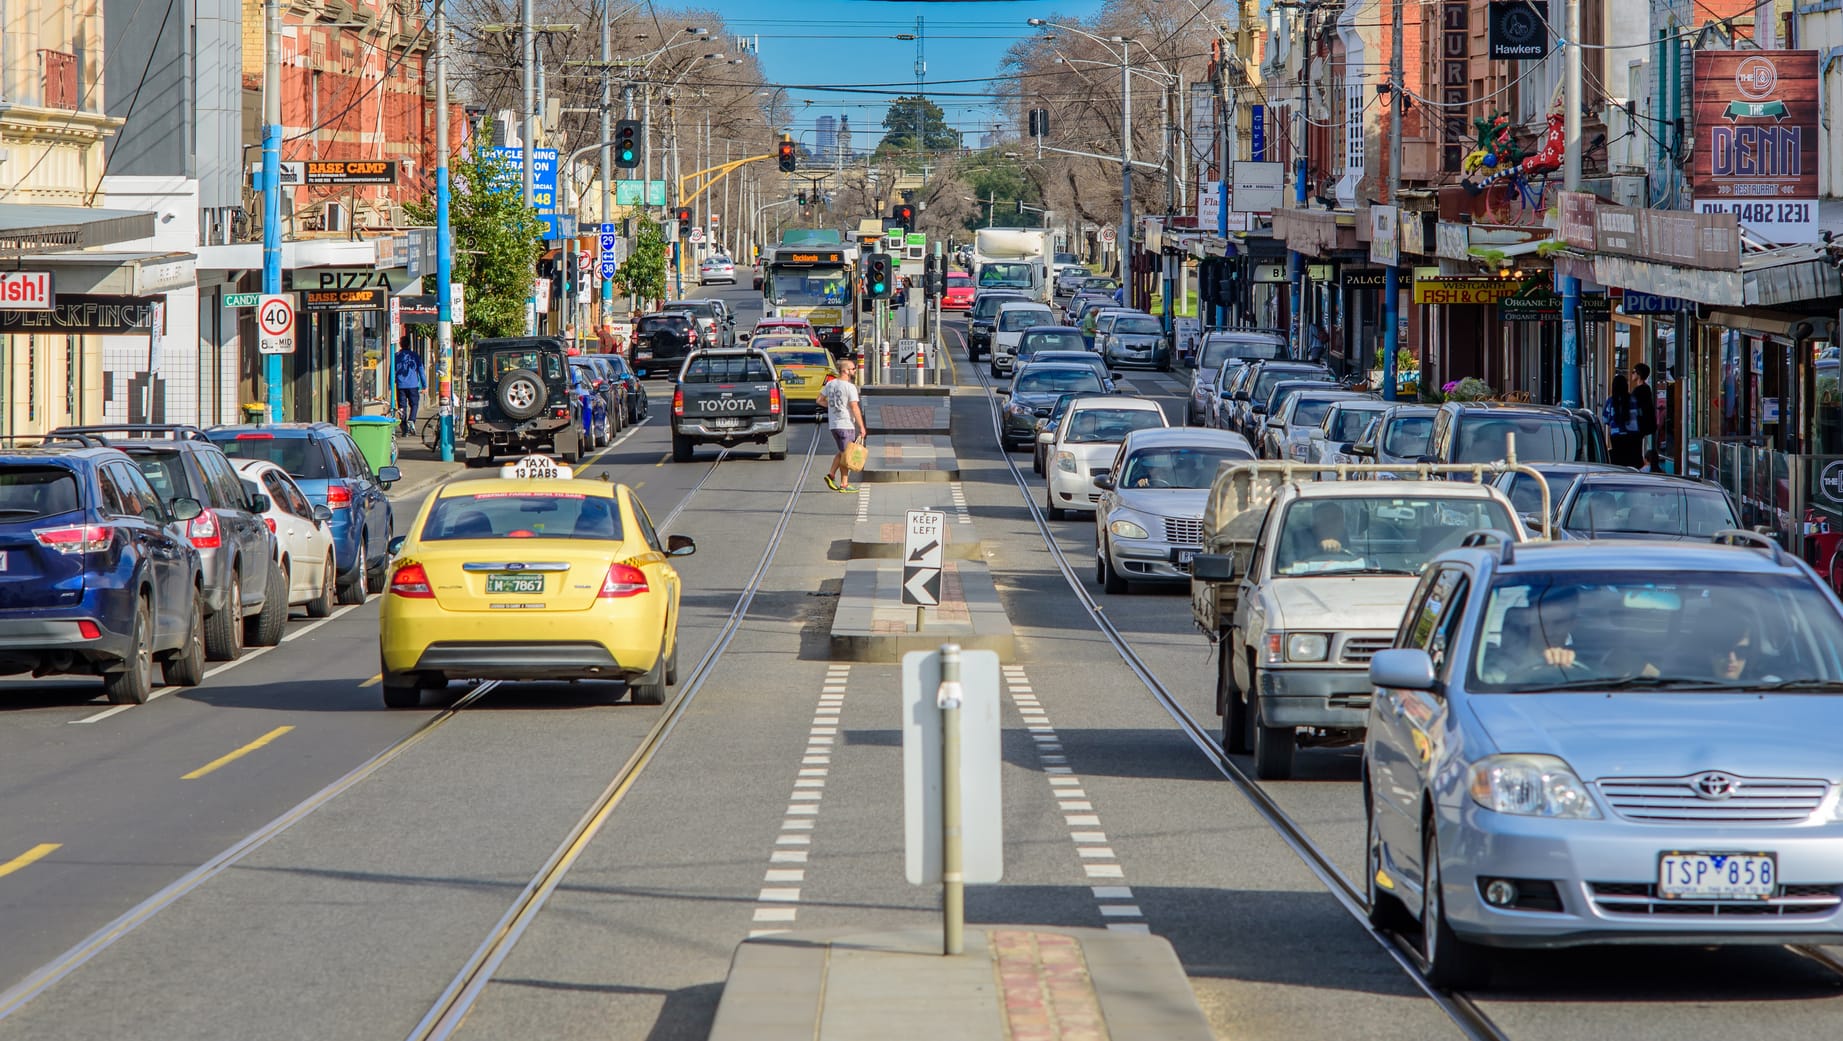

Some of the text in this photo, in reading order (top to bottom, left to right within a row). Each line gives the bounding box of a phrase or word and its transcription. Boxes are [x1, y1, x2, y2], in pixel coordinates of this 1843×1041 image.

[1495, 44, 1541, 54] Hawkers
[1740, 73, 1753, 82] THE
[1748, 104, 1763, 116] THE
[505, 150, 556, 160] CLENING
[1712, 126, 1802, 176] DENN
[309, 163, 387, 174] BASE CAMP
[1734, 184, 1779, 196] RESTAURANT
[1777, 203, 1810, 222] 1231
[602, 235, 613, 246] 29
[603, 264, 614, 273] 38
[320, 272, 392, 291] PIZZA
[1347, 275, 1387, 284] PALACE
[0, 274, 43, 302] ish!
[226, 296, 258, 306] CANDY
[308, 291, 374, 302] BASE CAMP
[1424, 290, 1457, 303] FISH
[1461, 290, 1472, 303] &
[1505, 297, 1546, 307] ORGANIC
[1583, 299, 1605, 307] TORE
[265, 309, 287, 325] 40
[1505, 313, 1537, 321] ORGANIC
[698, 399, 756, 411] TOYOTA
[524, 459, 549, 467] TAXI
[515, 469, 558, 478] 13 CABS
[1824, 477, 1838, 486] THE
[913, 515, 938, 525] KEEP
[913, 526, 937, 535] LEFT
[512, 580, 543, 591] 7867
[1666, 860, 1771, 885] TSP 858
